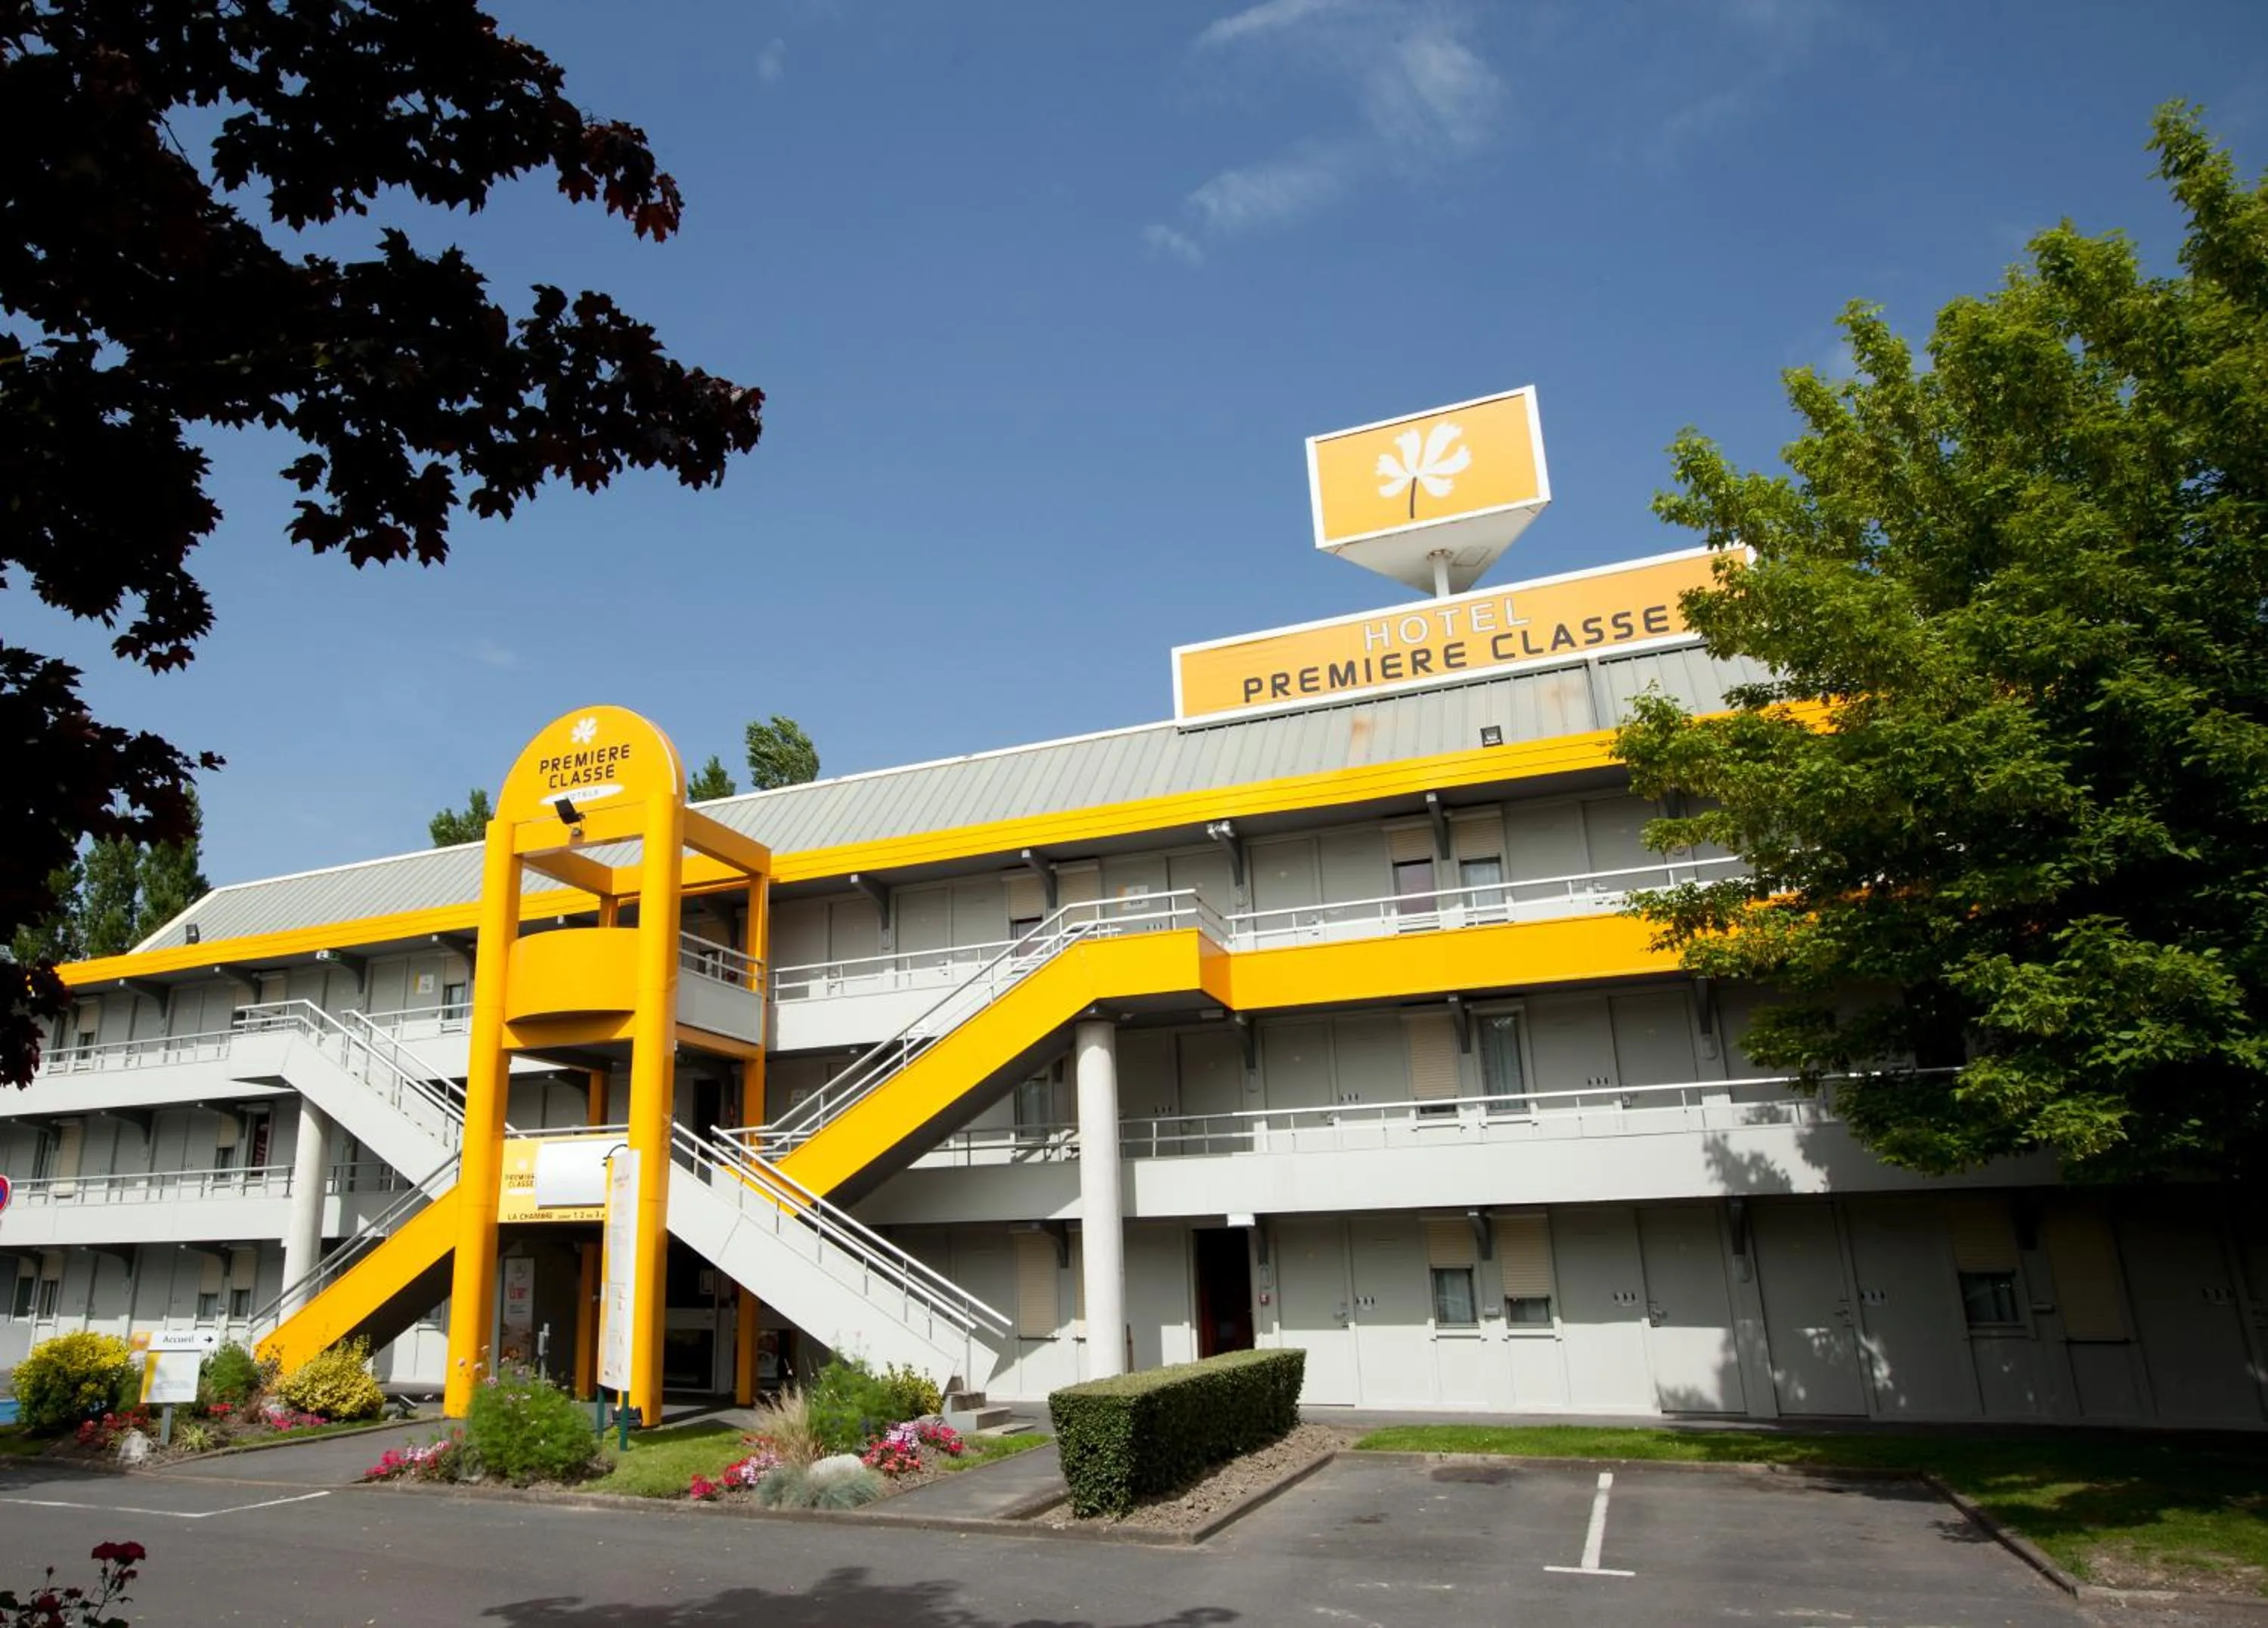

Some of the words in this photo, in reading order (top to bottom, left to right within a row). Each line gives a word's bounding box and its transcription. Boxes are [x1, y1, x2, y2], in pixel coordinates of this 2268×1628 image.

[1364, 598, 1530, 652] HOTEL
[1243, 642, 1467, 704] PREMIERE
[1491, 605, 1670, 661] CLASSE
[539, 744, 631, 774] PREMIERE
[550, 764, 615, 788] CLASSE
[565, 788, 600, 801] OTELS
[519, 1212, 553, 1220] CHAMBRE
[163, 1335, 194, 1343] Accueil
